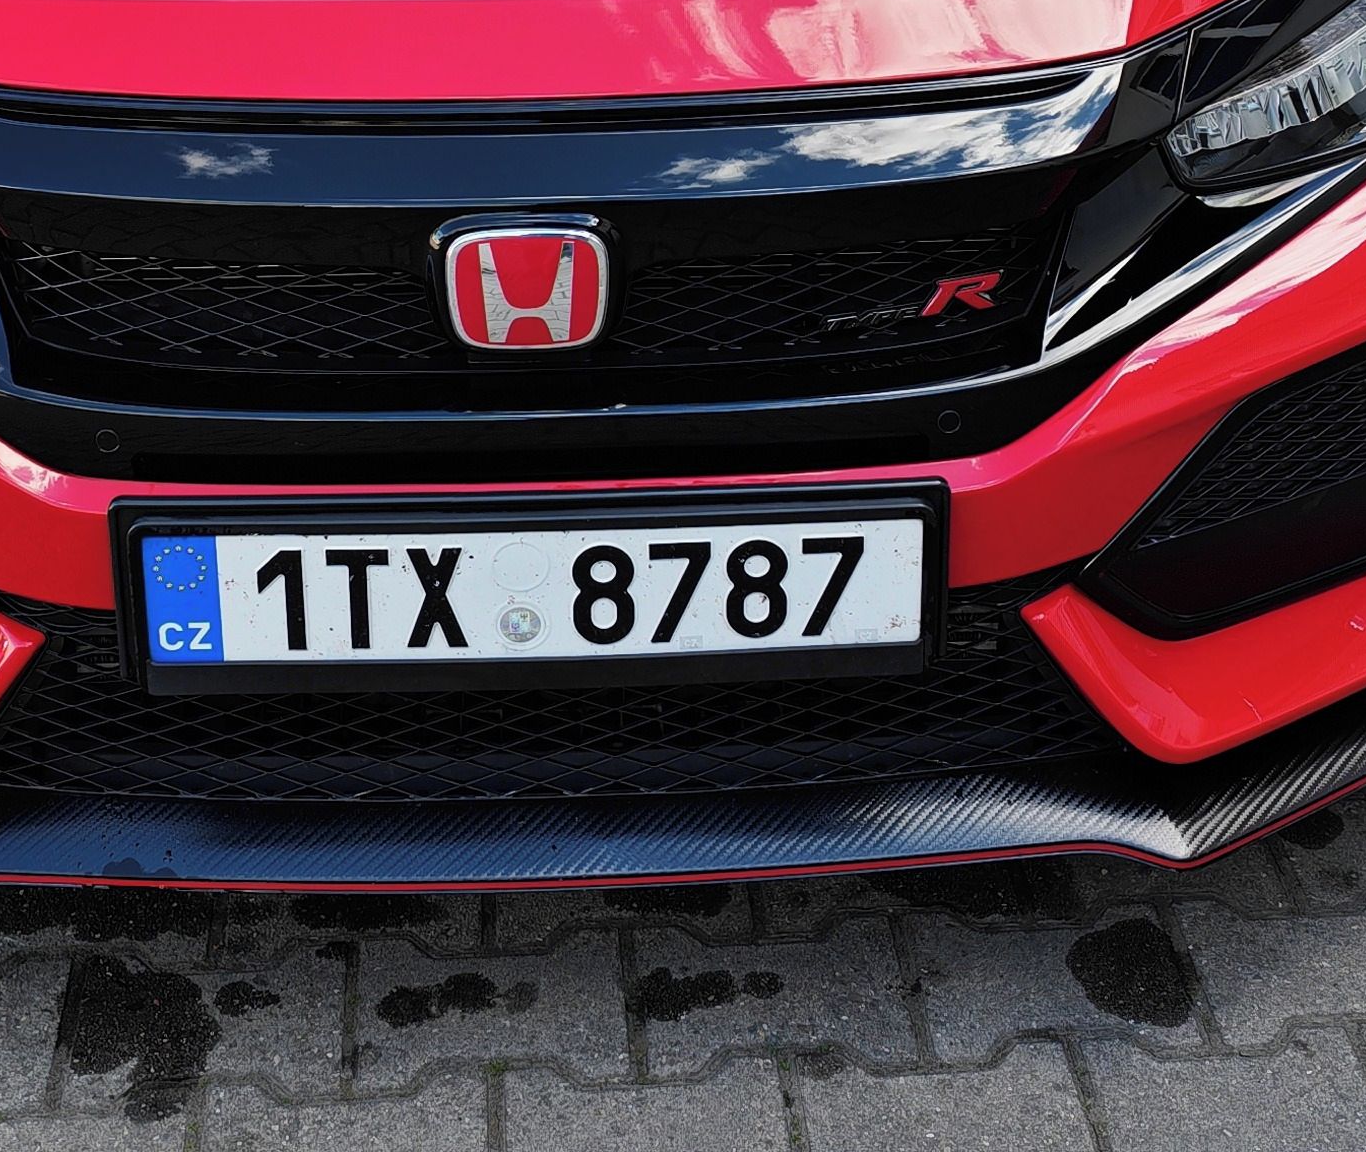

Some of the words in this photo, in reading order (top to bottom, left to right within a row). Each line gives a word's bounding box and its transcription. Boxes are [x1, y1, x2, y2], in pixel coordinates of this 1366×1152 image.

[919, 272, 1003, 318] R
[256, 547, 470, 651] 1TX
[571, 535, 865, 645] 8787
[158, 621, 213, 651] CZ
